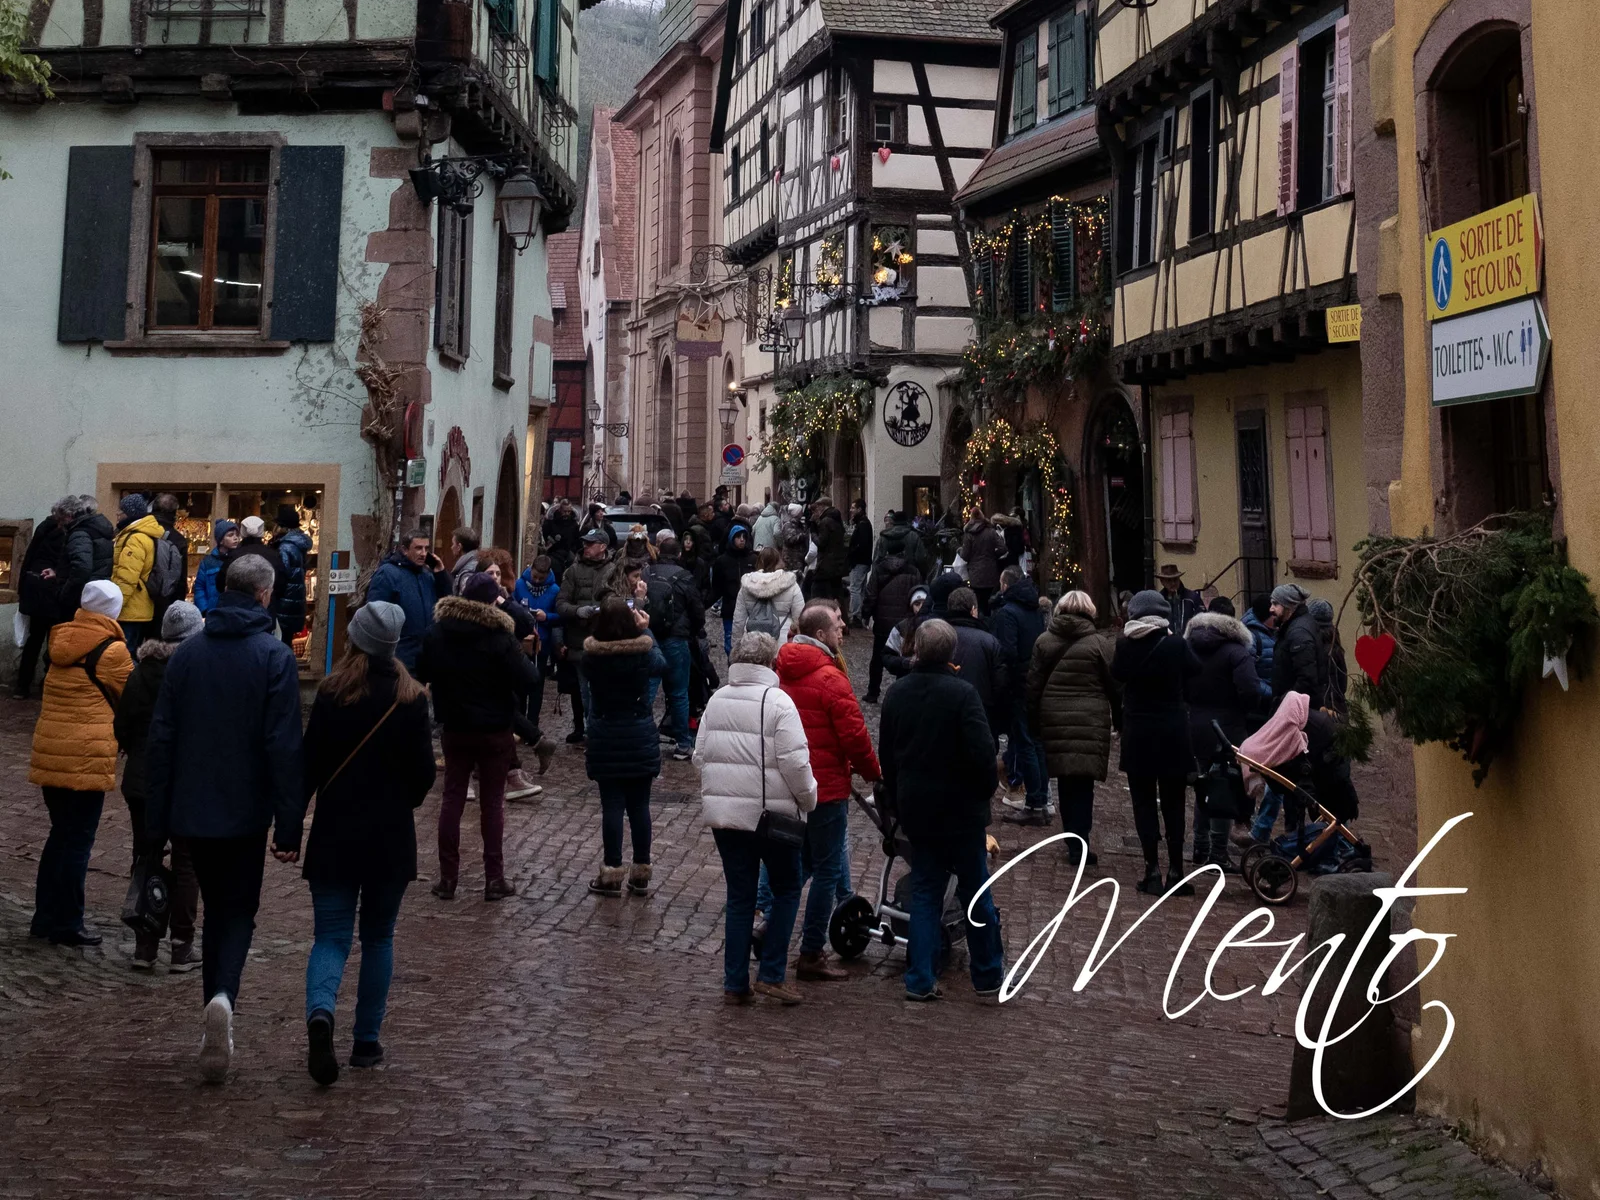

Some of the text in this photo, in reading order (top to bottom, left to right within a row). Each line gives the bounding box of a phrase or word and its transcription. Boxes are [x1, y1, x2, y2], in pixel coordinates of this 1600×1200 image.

[1459, 209, 1524, 263] SORTIE DE
[1463, 252, 1522, 302] SECOURS
[1330, 307, 1359, 323] SORTIE DE
[1332, 323, 1359, 338] SECOURS
[1434, 337, 1484, 378] TOILETTES
[1492, 330, 1517, 367] W.C.
